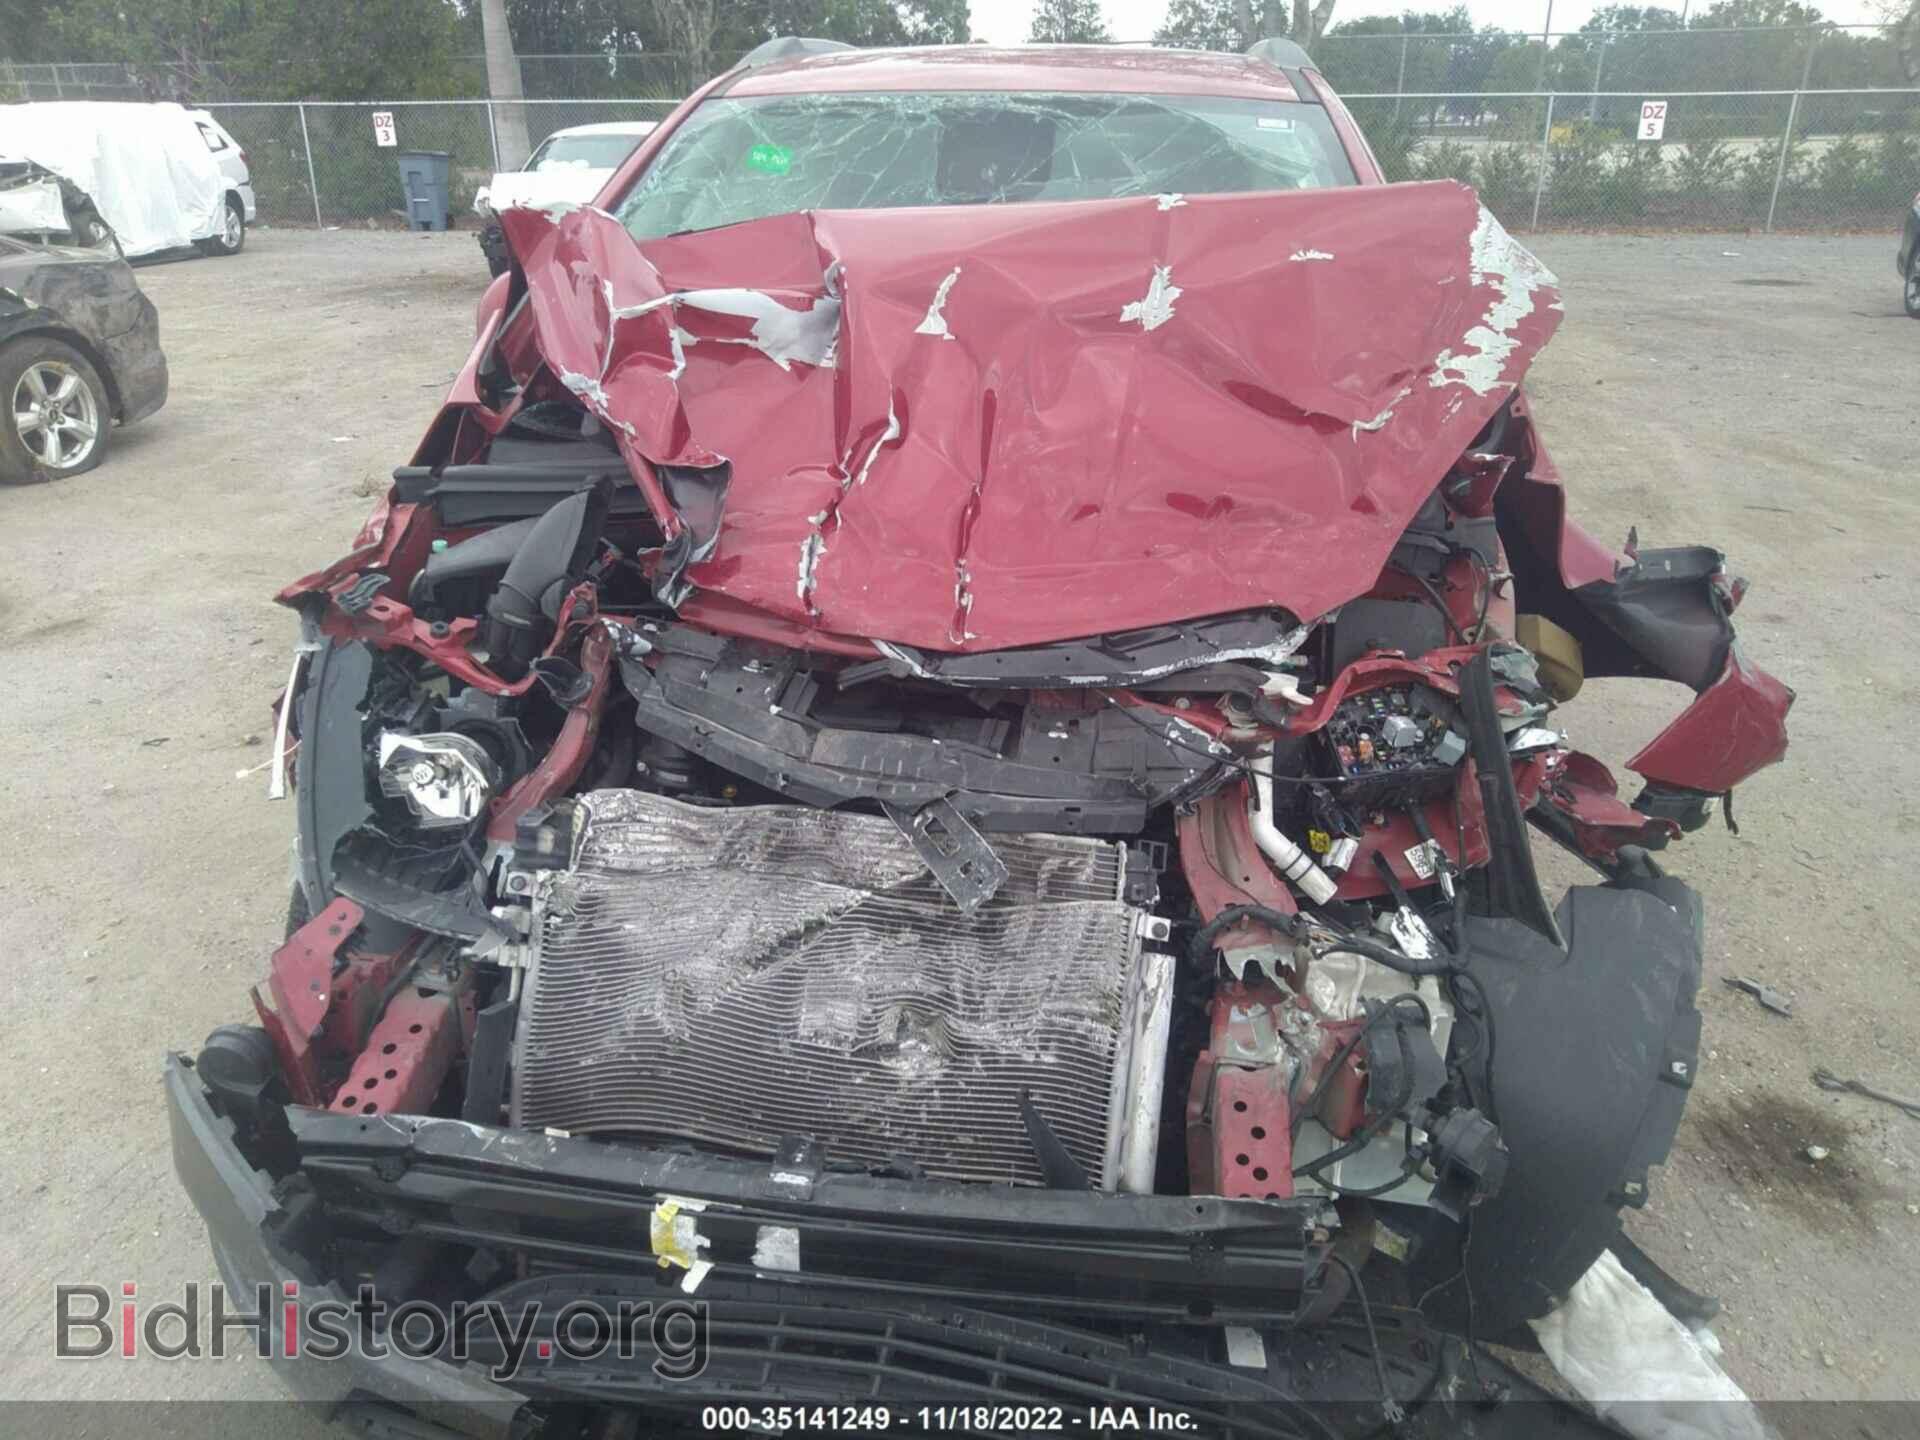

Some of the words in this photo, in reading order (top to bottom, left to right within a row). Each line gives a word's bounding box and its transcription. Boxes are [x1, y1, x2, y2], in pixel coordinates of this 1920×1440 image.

[1643, 105, 1664, 119] DZ
[375, 115, 392, 128] DZ
[383, 130, 390, 141] 3
[1645, 123, 1654, 136] 5
